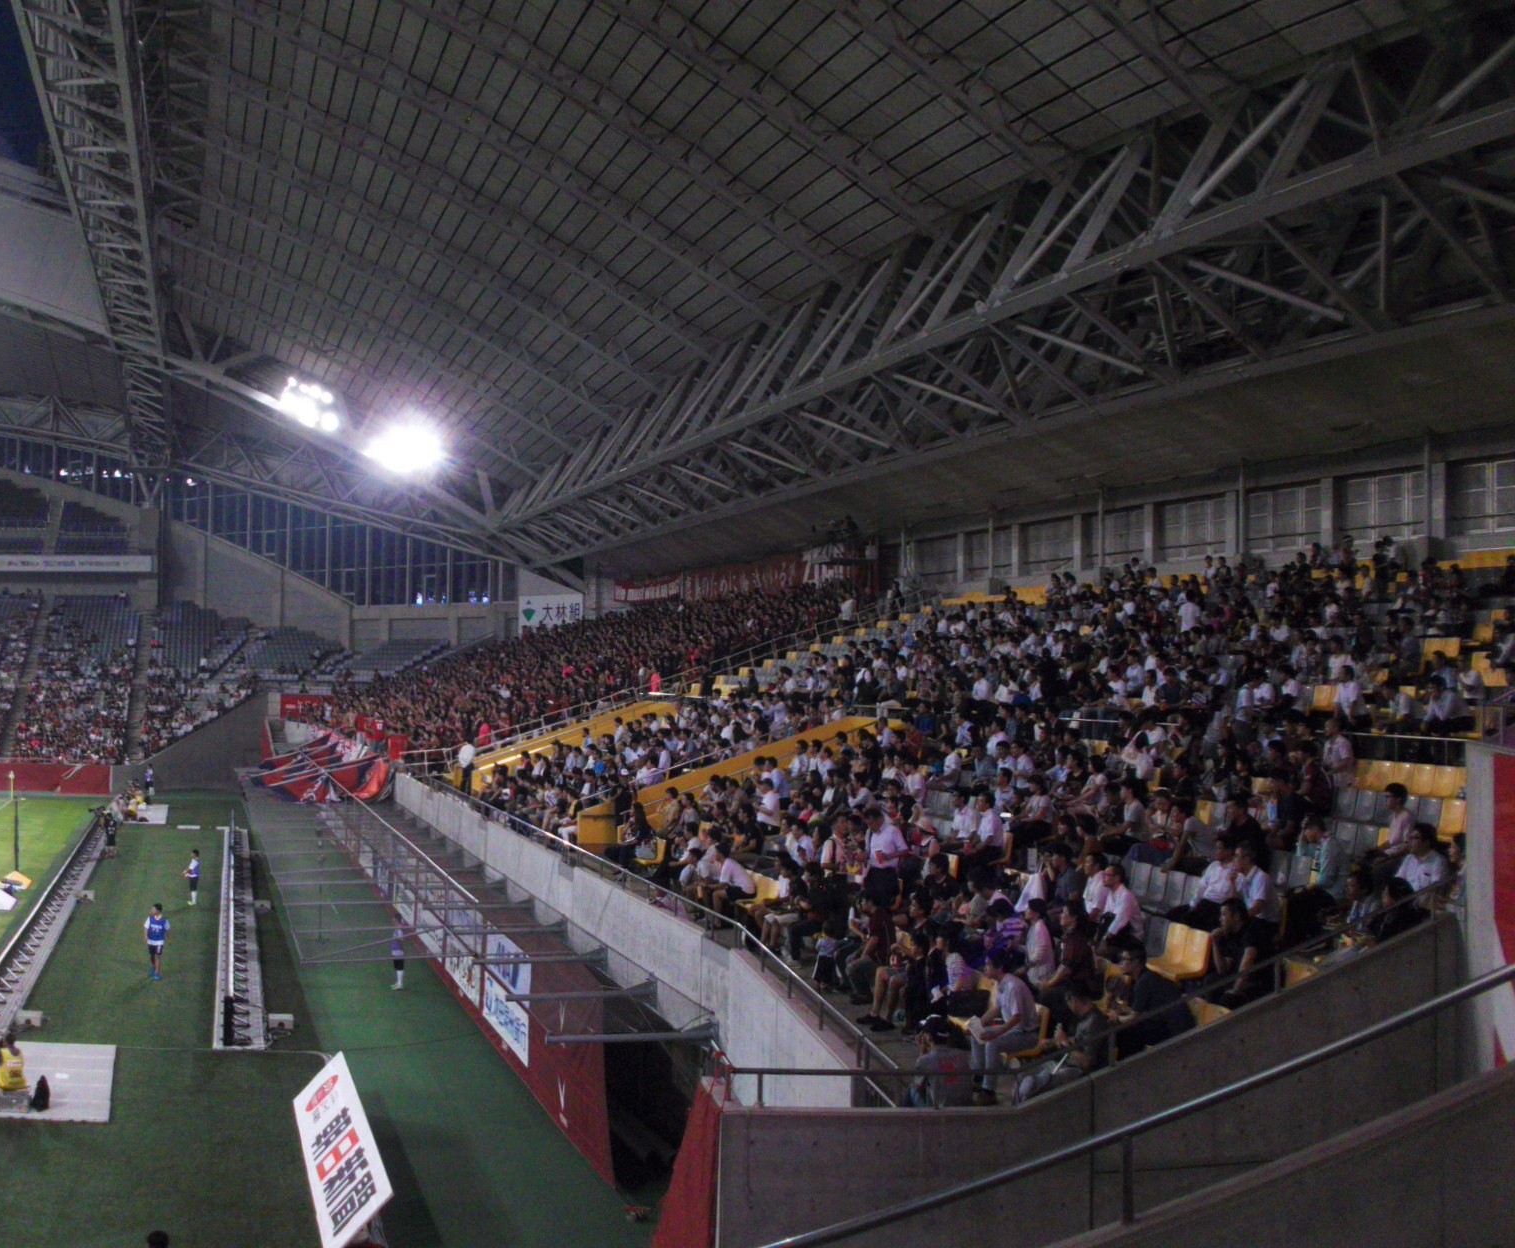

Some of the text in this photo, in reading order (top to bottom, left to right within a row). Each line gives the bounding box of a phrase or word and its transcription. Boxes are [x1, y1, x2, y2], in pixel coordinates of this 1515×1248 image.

[542, 602, 580, 621] 大林組
[311, 1106, 377, 1238] 朝日新聞
